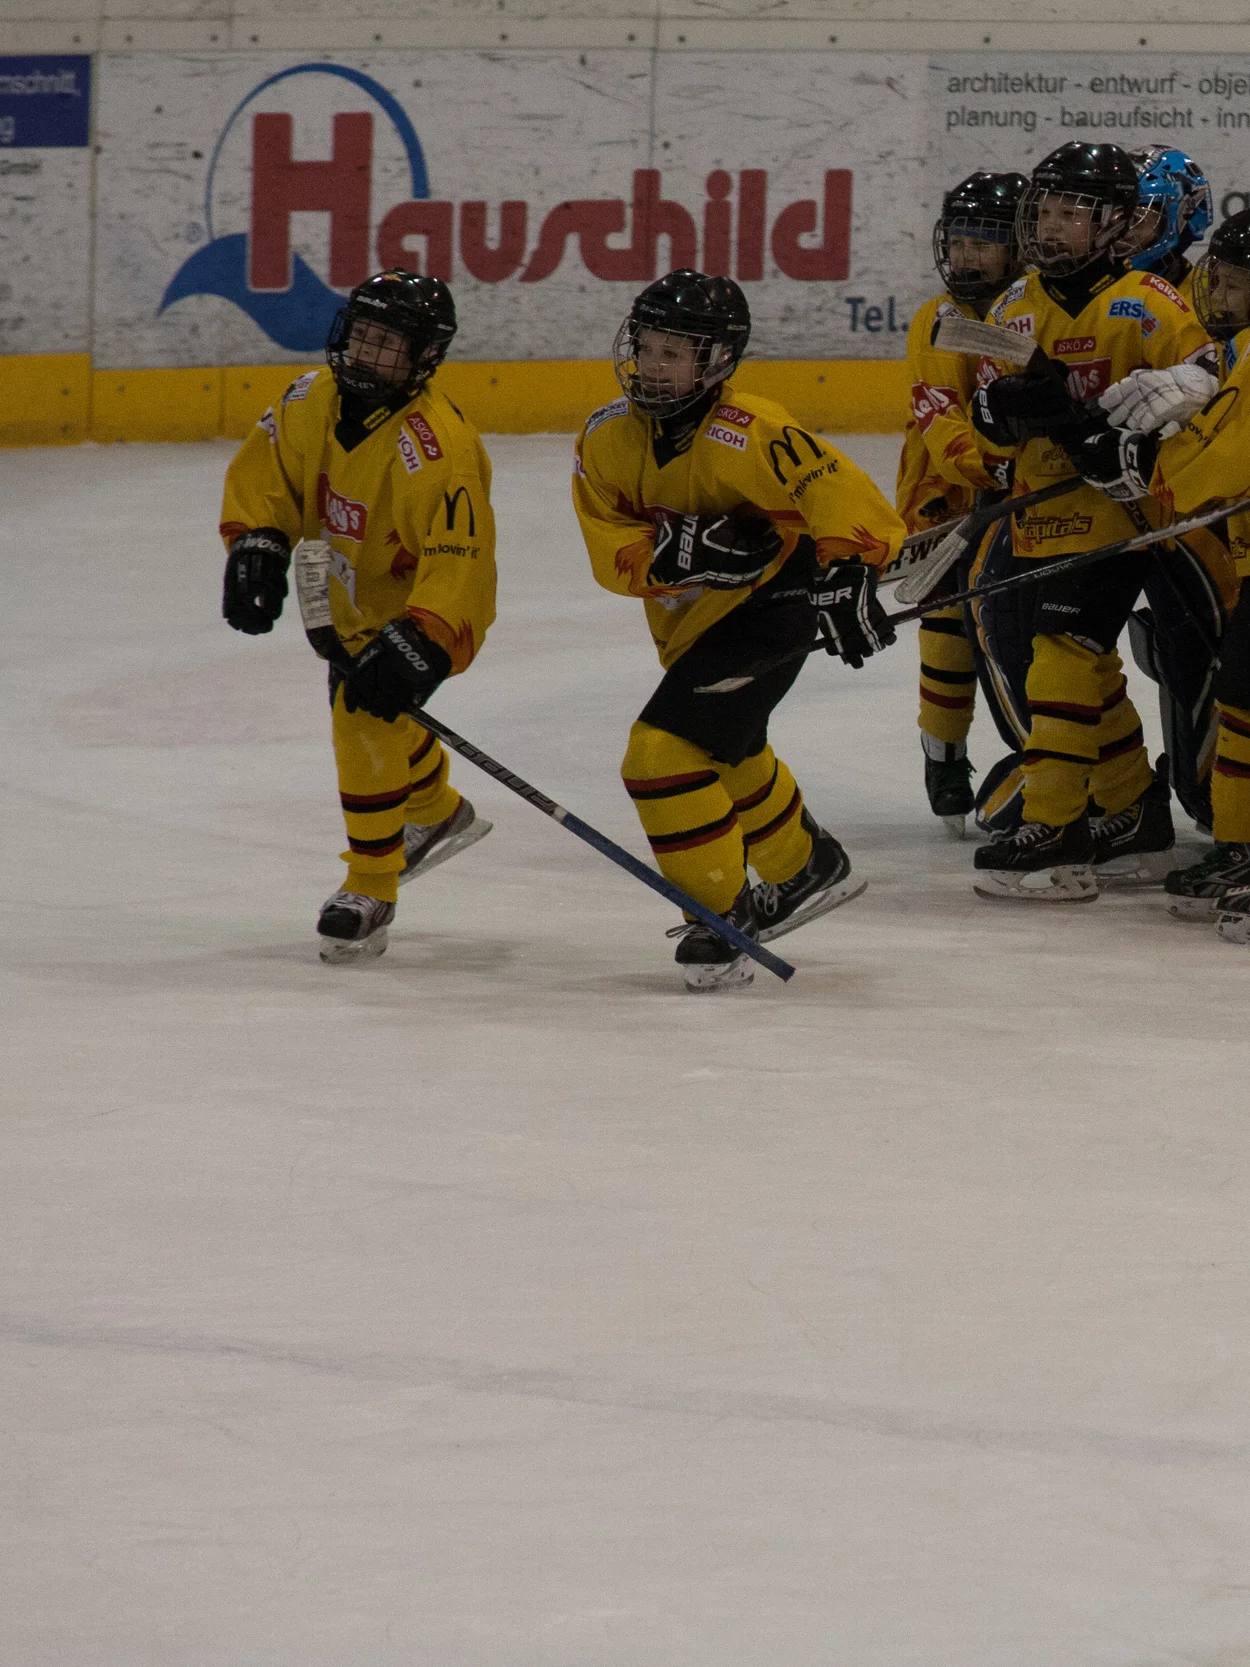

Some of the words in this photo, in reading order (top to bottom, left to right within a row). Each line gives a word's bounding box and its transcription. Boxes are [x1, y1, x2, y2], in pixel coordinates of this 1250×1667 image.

[947, 72, 1068, 94] architektur
[1090, 72, 1177, 94] entwurf
[945, 107, 1037, 132] planung
[1060, 107, 1193, 129] bauaufsicht
[250, 112, 853, 289] Hauschild
[845, 295, 909, 332] Tel.
[717, 404, 740, 420] SKÖ
[1041, 602, 1082, 615] BAUER
